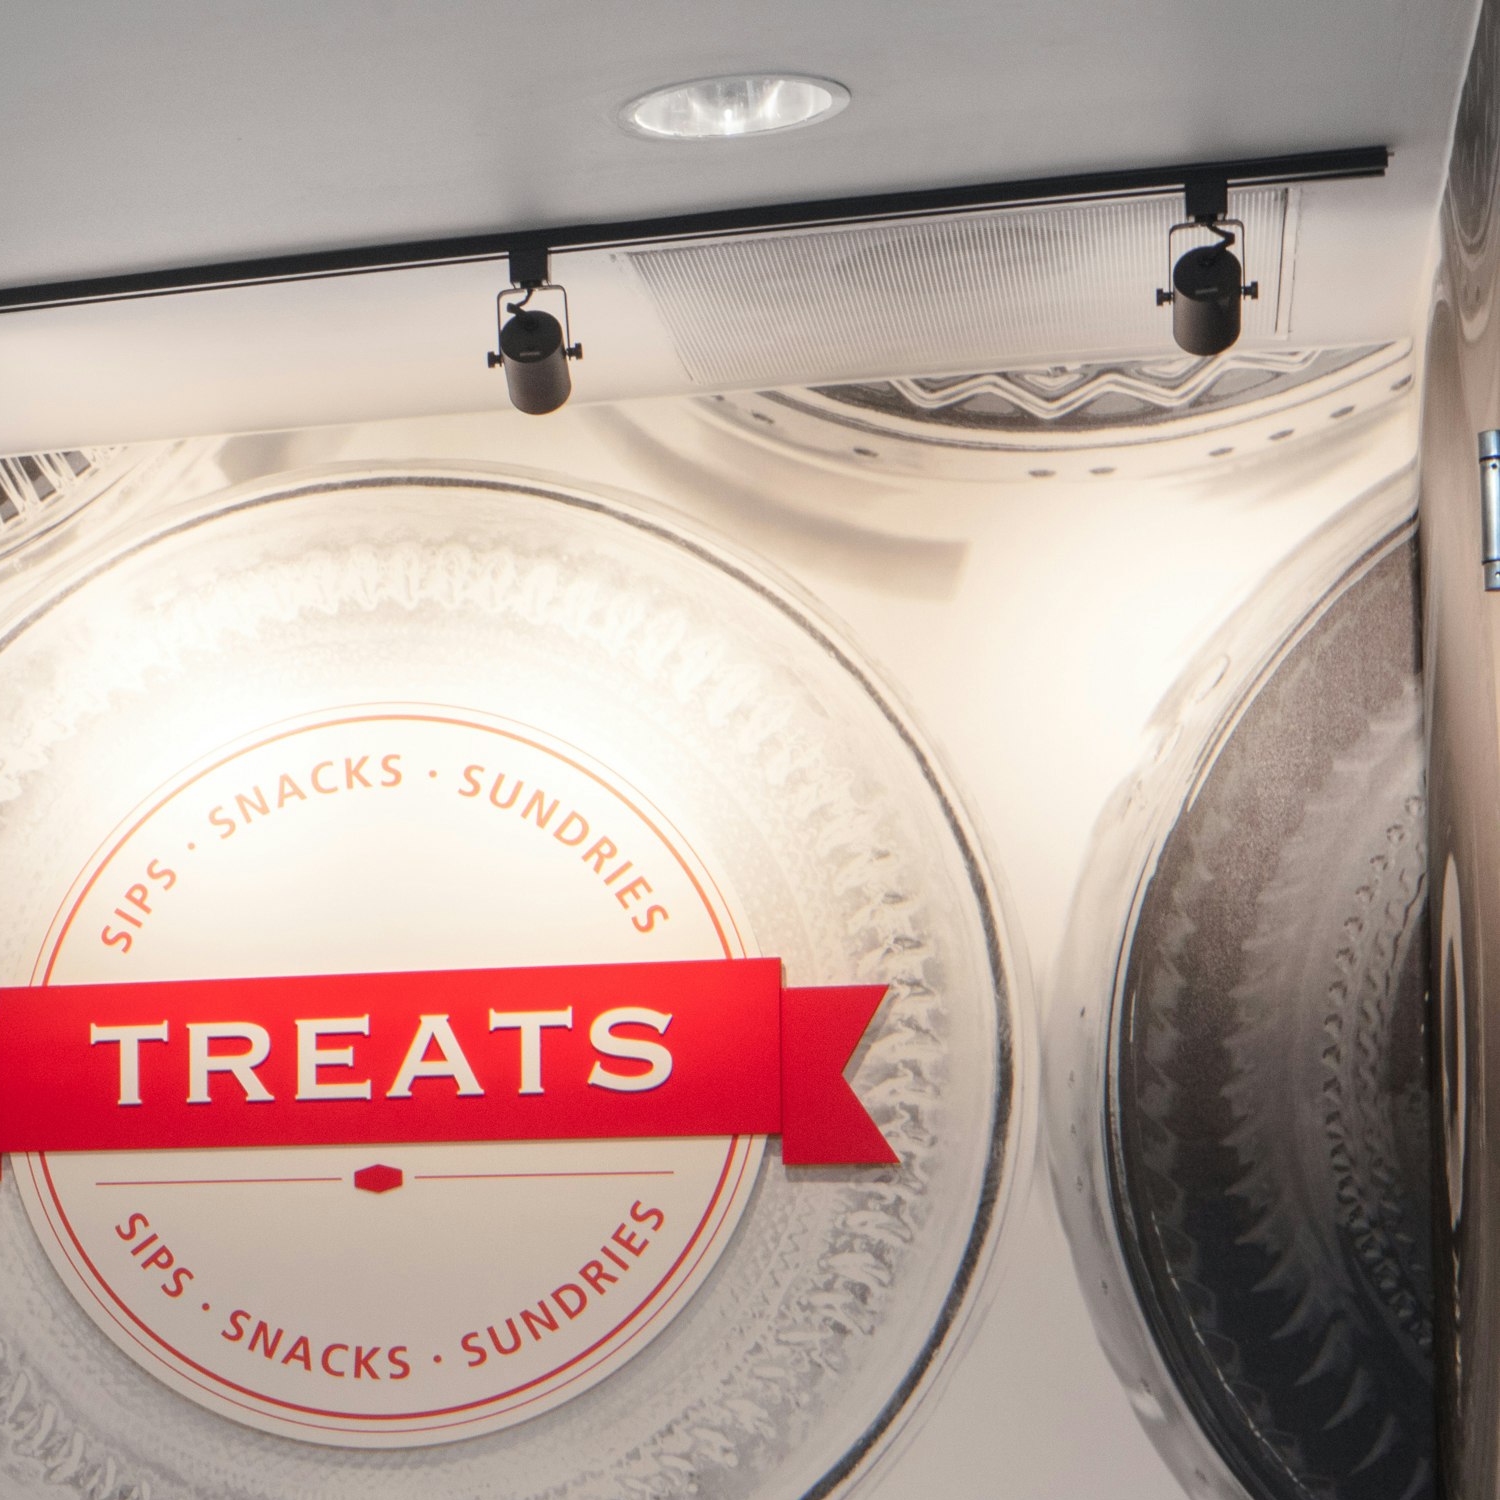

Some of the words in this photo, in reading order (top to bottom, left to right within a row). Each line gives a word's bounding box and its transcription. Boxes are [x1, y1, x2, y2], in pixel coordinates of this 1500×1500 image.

[99, 857, 177, 956] SIPS
[208, 752, 406, 841] SNACKS
[458, 763, 672, 938] SUNDRIES
[89, 1005, 675, 1107] TREATS
[115, 1211, 194, 1301] SIPS
[220, 1308, 412, 1381] SNACKS
[460, 1196, 667, 1368] SUNDRIES
